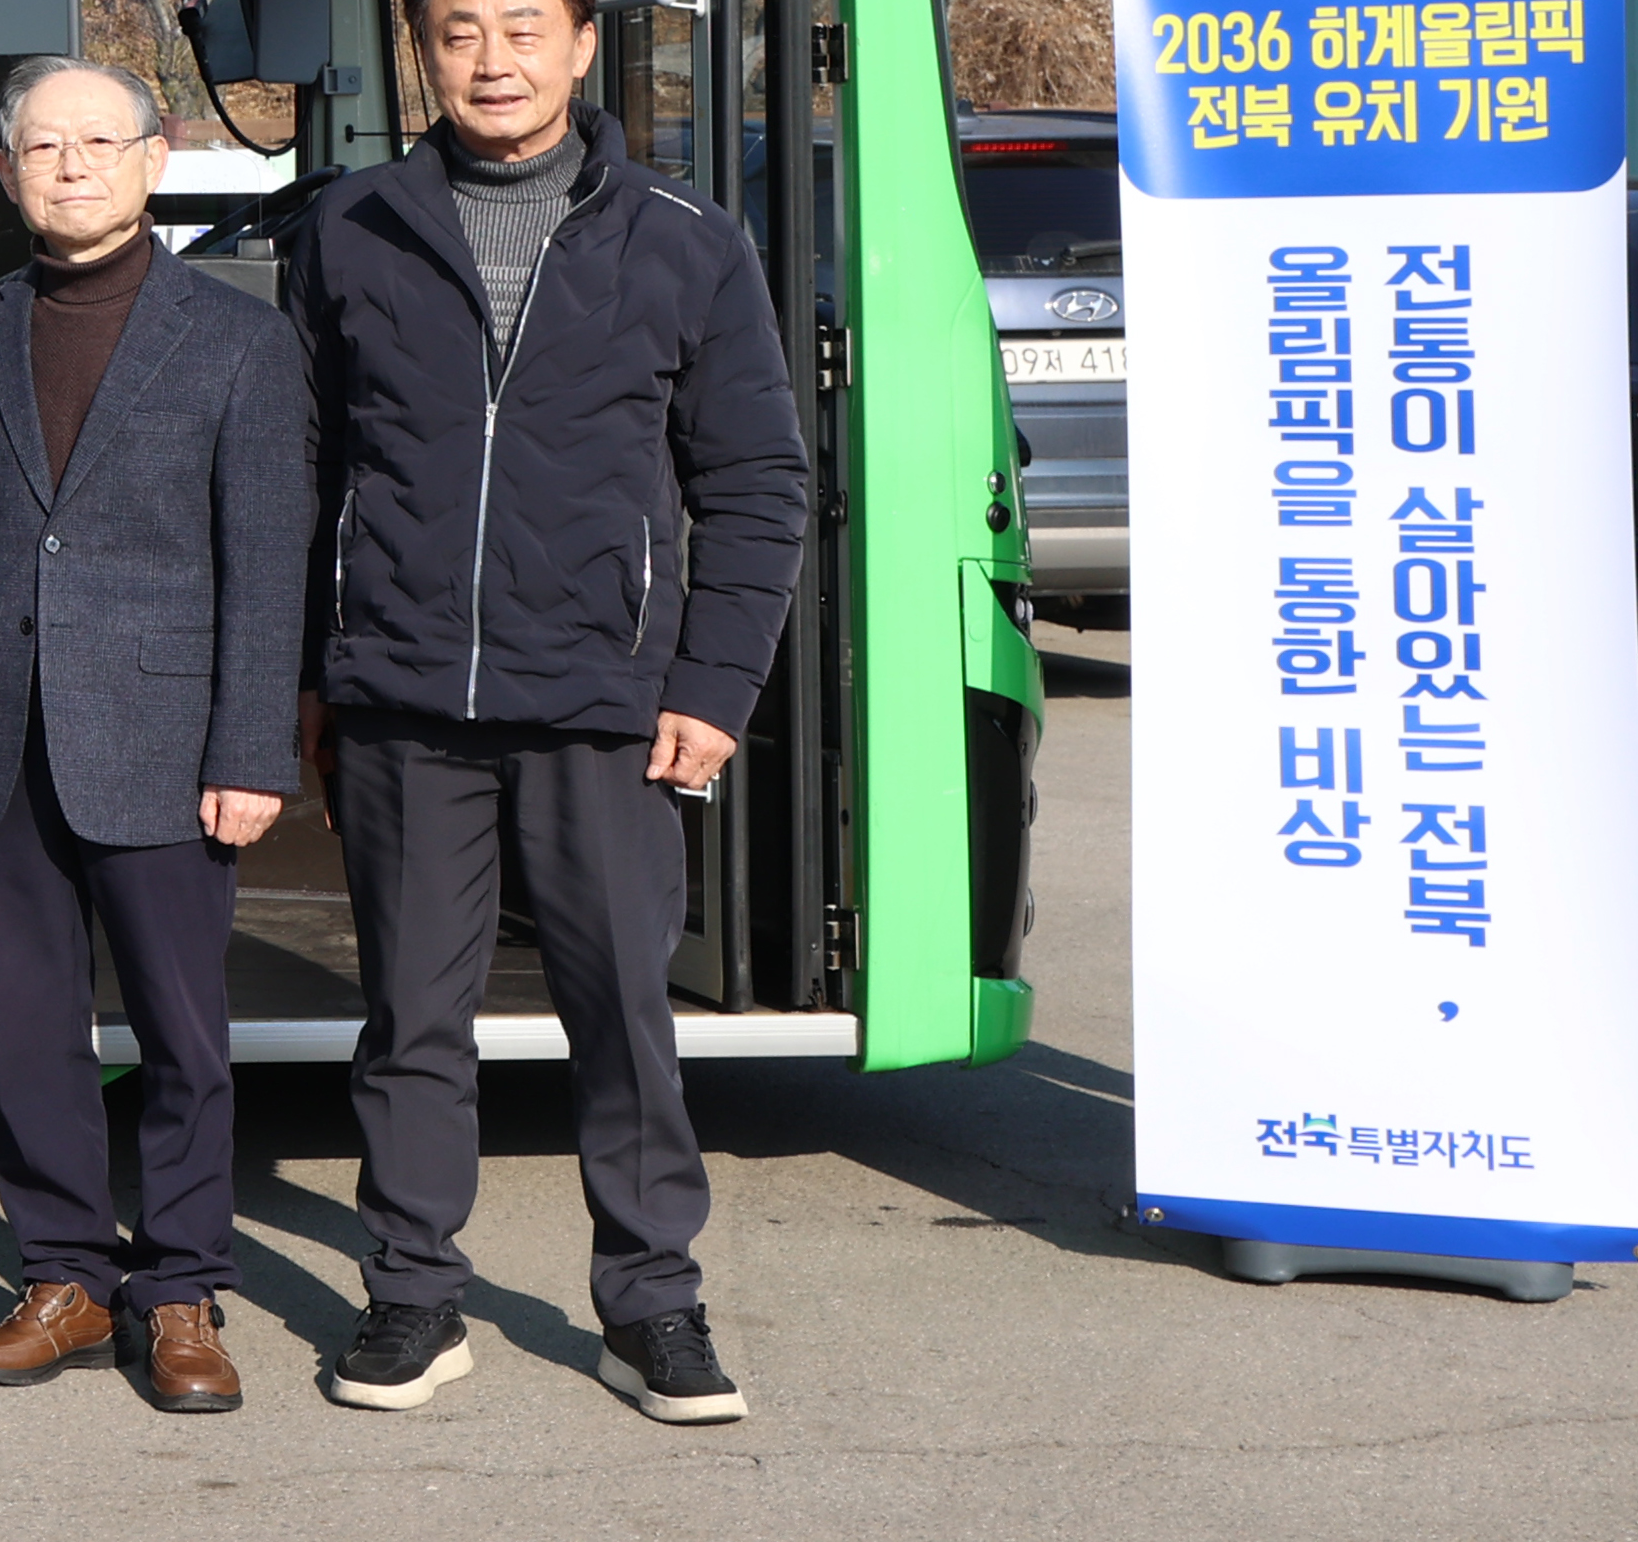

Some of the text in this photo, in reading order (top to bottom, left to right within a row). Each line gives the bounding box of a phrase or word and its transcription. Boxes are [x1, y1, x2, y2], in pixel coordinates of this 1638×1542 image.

[1152, 10, 1292, 75] 2036
[1188, 76, 1549, 150] 전북 유치 기원
[1385, 244, 1476, 455] 전통이
[1266, 245, 1372, 868] 올림픽을 통한 비상
[1389, 486, 1487, 772] 살아있는
